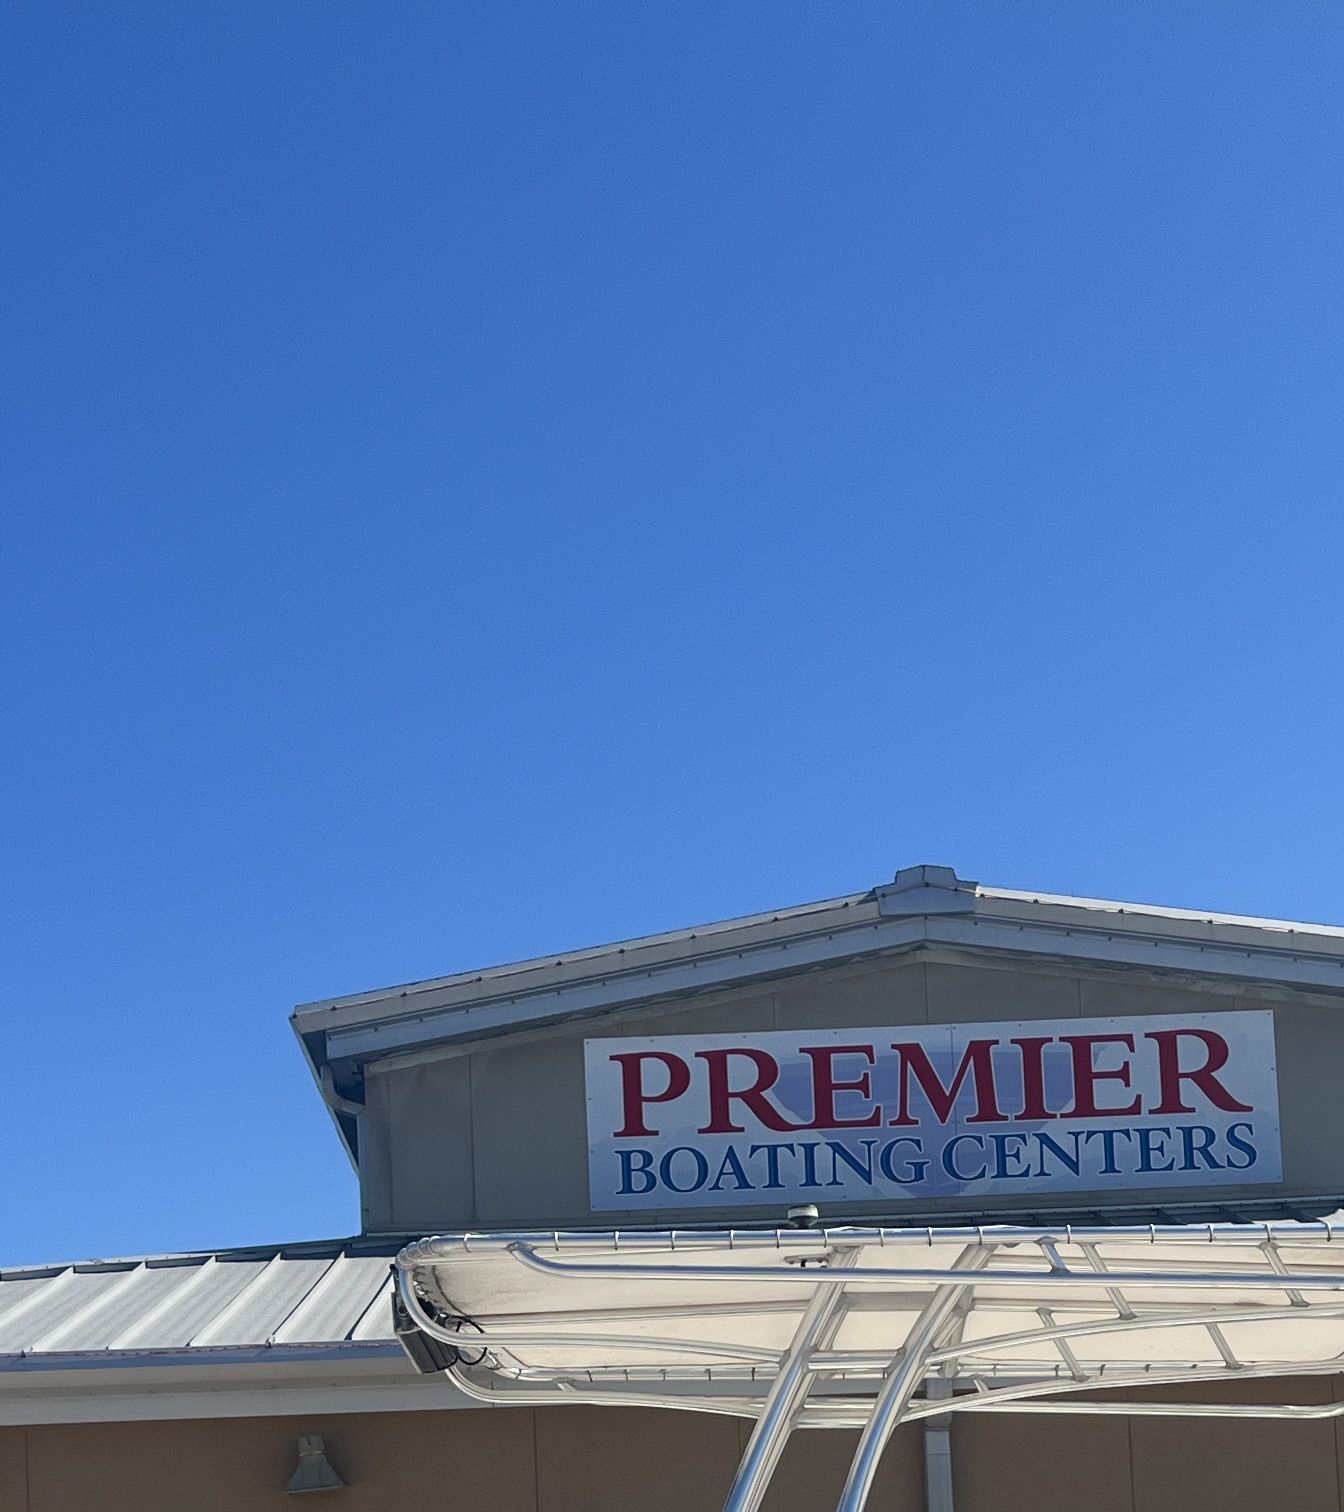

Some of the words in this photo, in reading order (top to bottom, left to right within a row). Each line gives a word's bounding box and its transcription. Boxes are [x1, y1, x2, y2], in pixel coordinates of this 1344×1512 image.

[609, 1028, 1256, 1138] PREMIER
[615, 1136, 932, 1196] BOATING
[941, 1121, 1258, 1181] CENTERS
